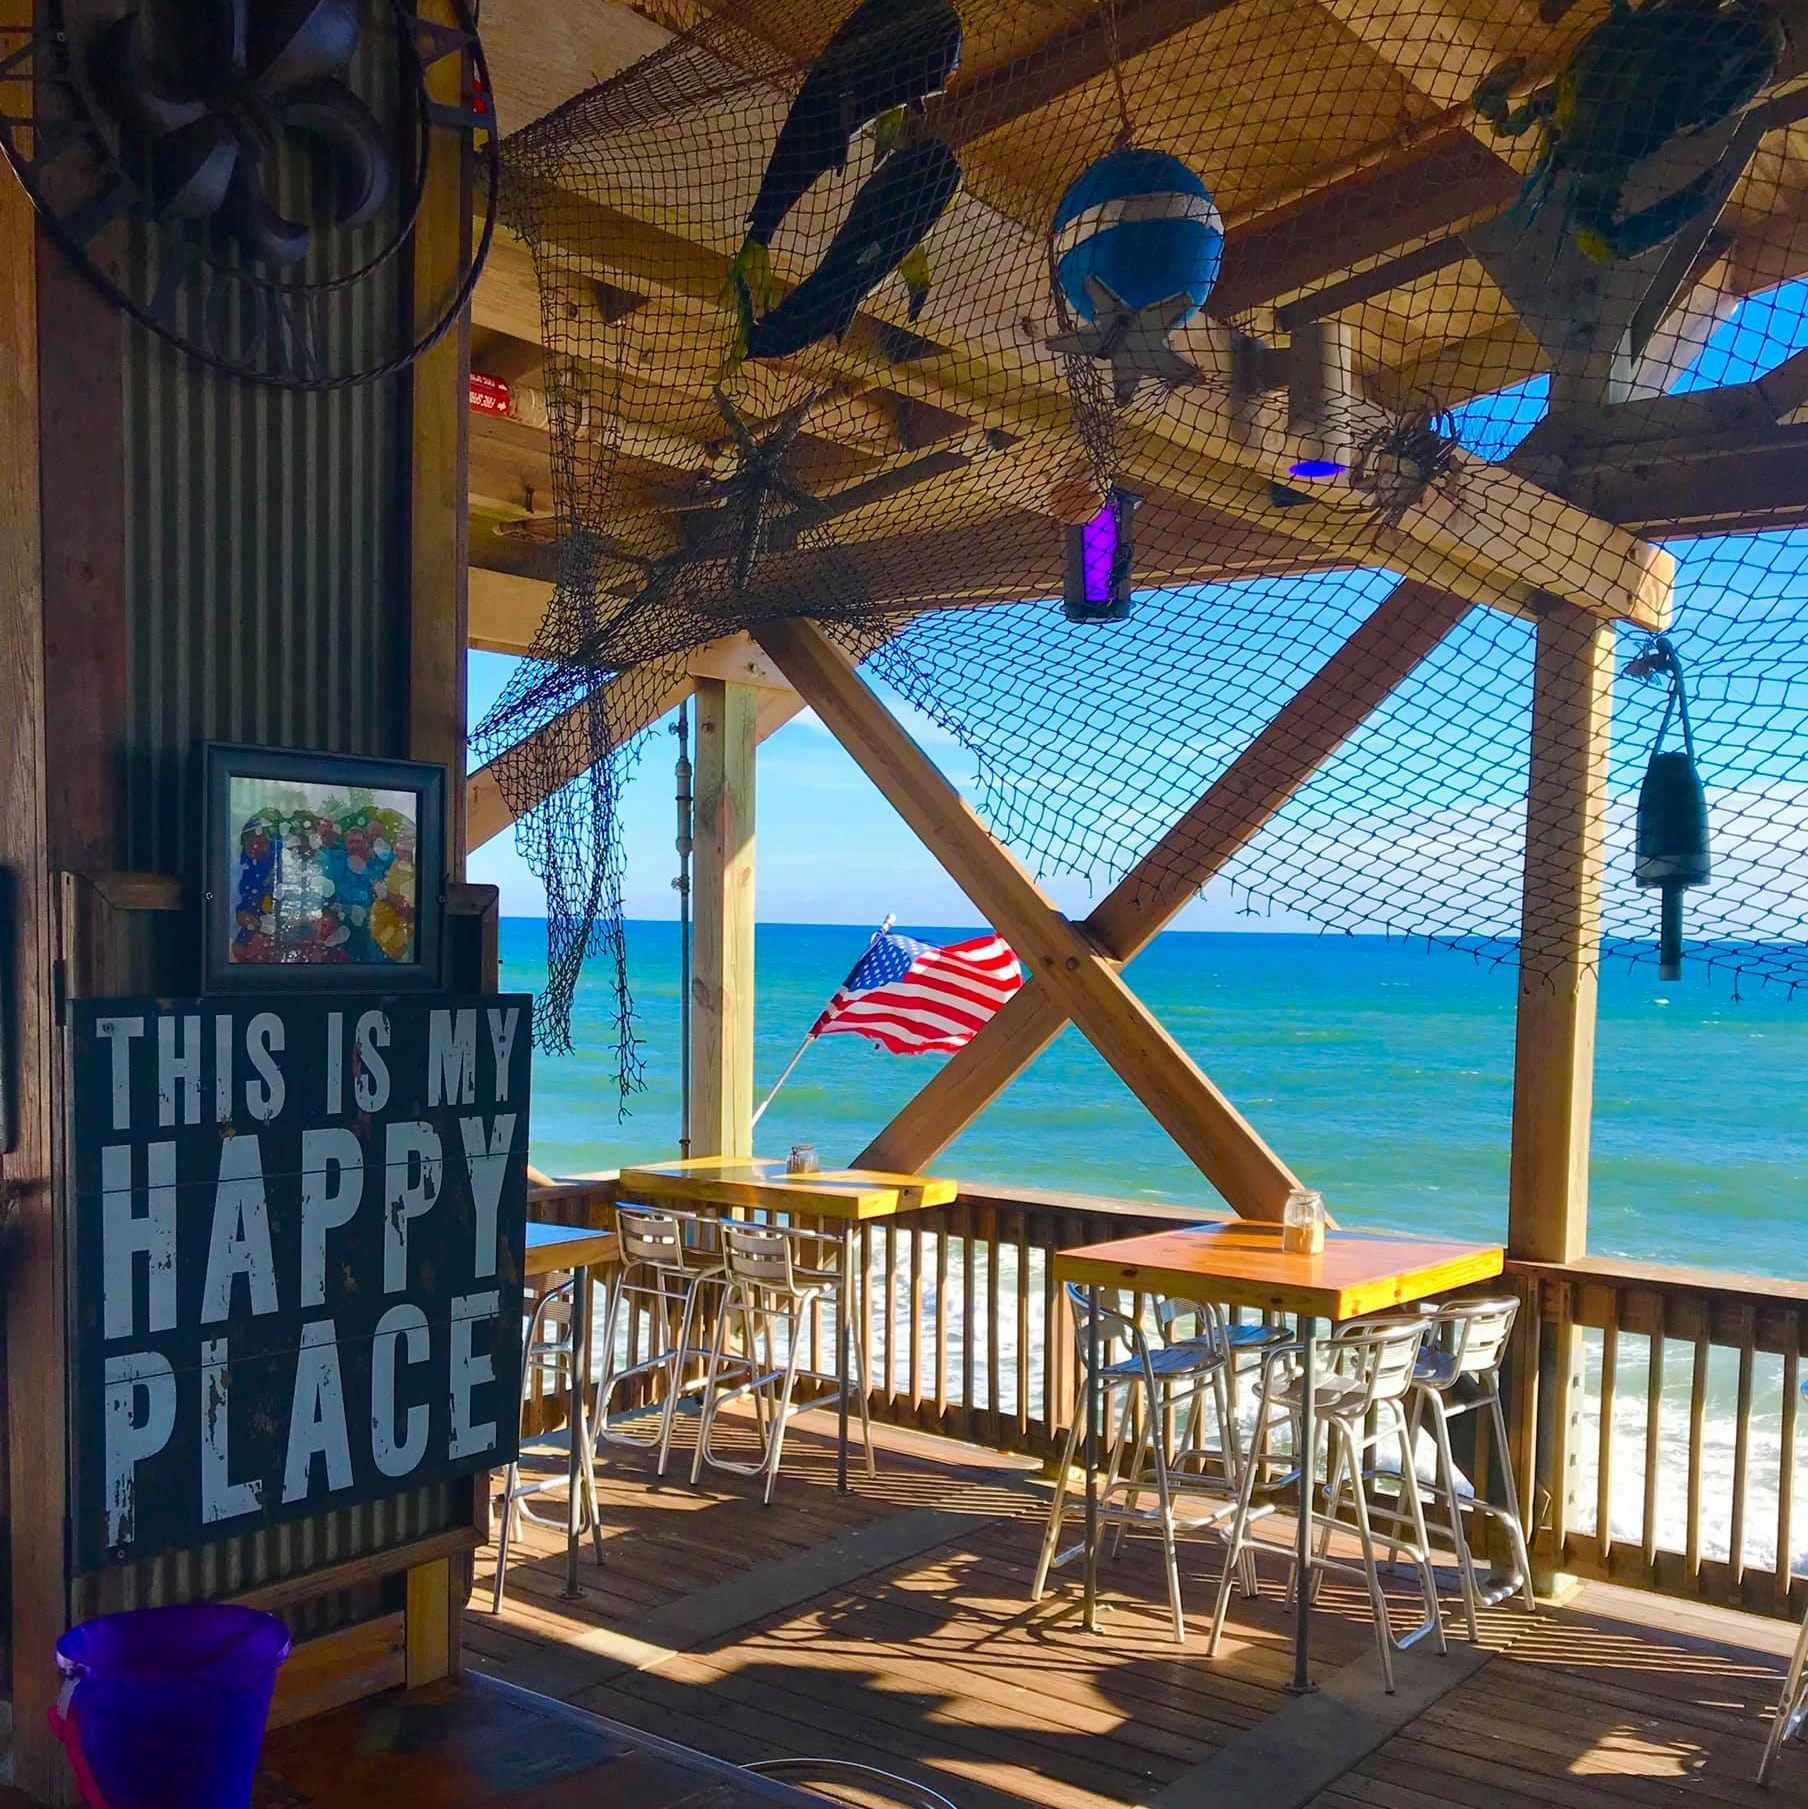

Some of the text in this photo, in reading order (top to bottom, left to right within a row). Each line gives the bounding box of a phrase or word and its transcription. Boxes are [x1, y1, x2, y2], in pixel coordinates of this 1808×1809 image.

[96, 1007, 521, 1130] THIS IS MY
[101, 1113, 517, 1340] HAPPY
[104, 1290, 500, 1547] PLACE
